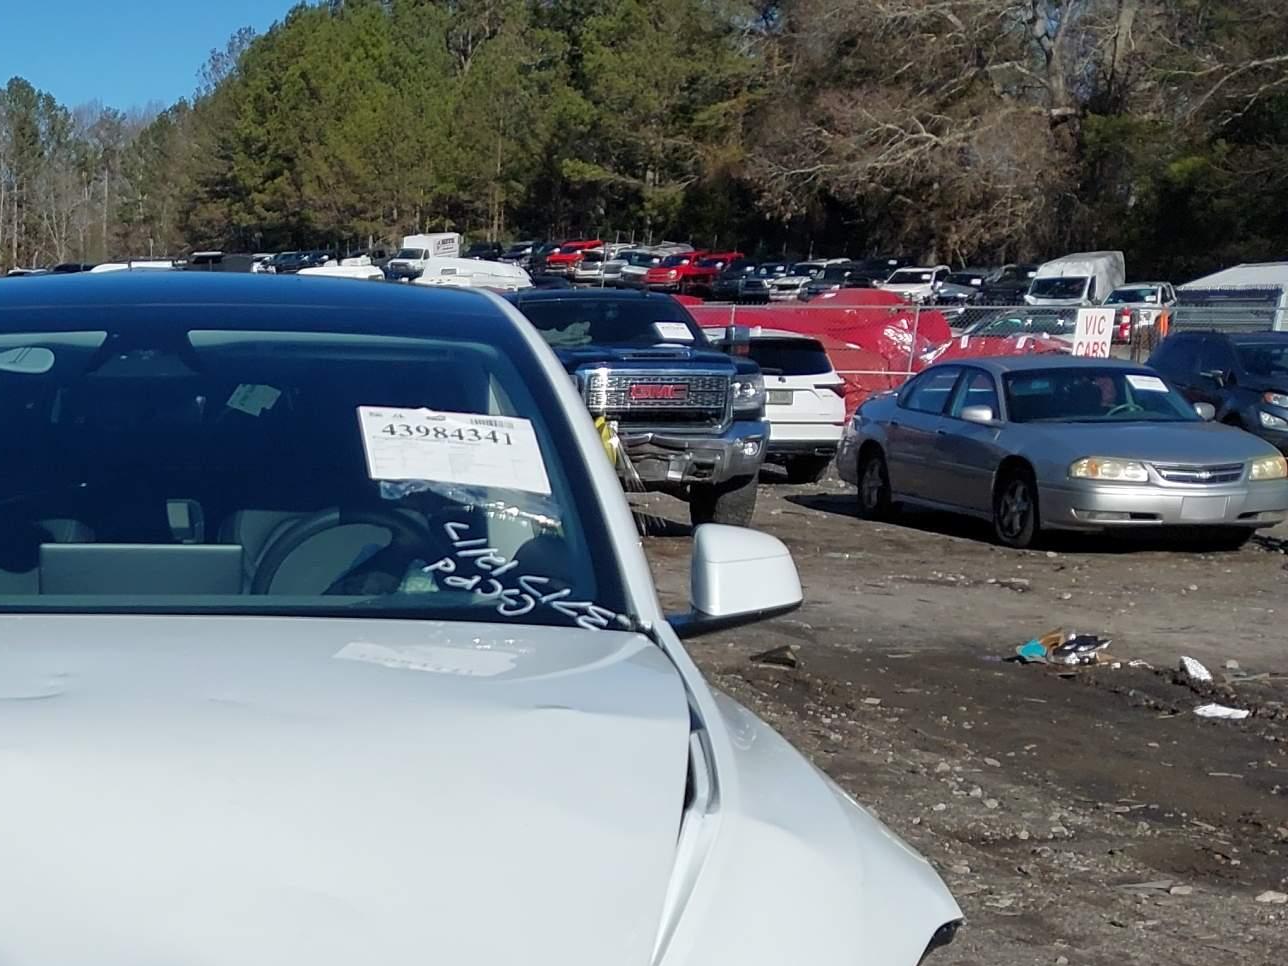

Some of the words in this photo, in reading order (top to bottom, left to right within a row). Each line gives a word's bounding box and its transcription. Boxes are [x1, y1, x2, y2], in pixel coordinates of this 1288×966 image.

[1085, 315, 1107, 336] VIC
[631, 384, 688, 400] GMC
[381, 423, 514, 446] 43984341
[444, 522, 520, 577] 12/17
